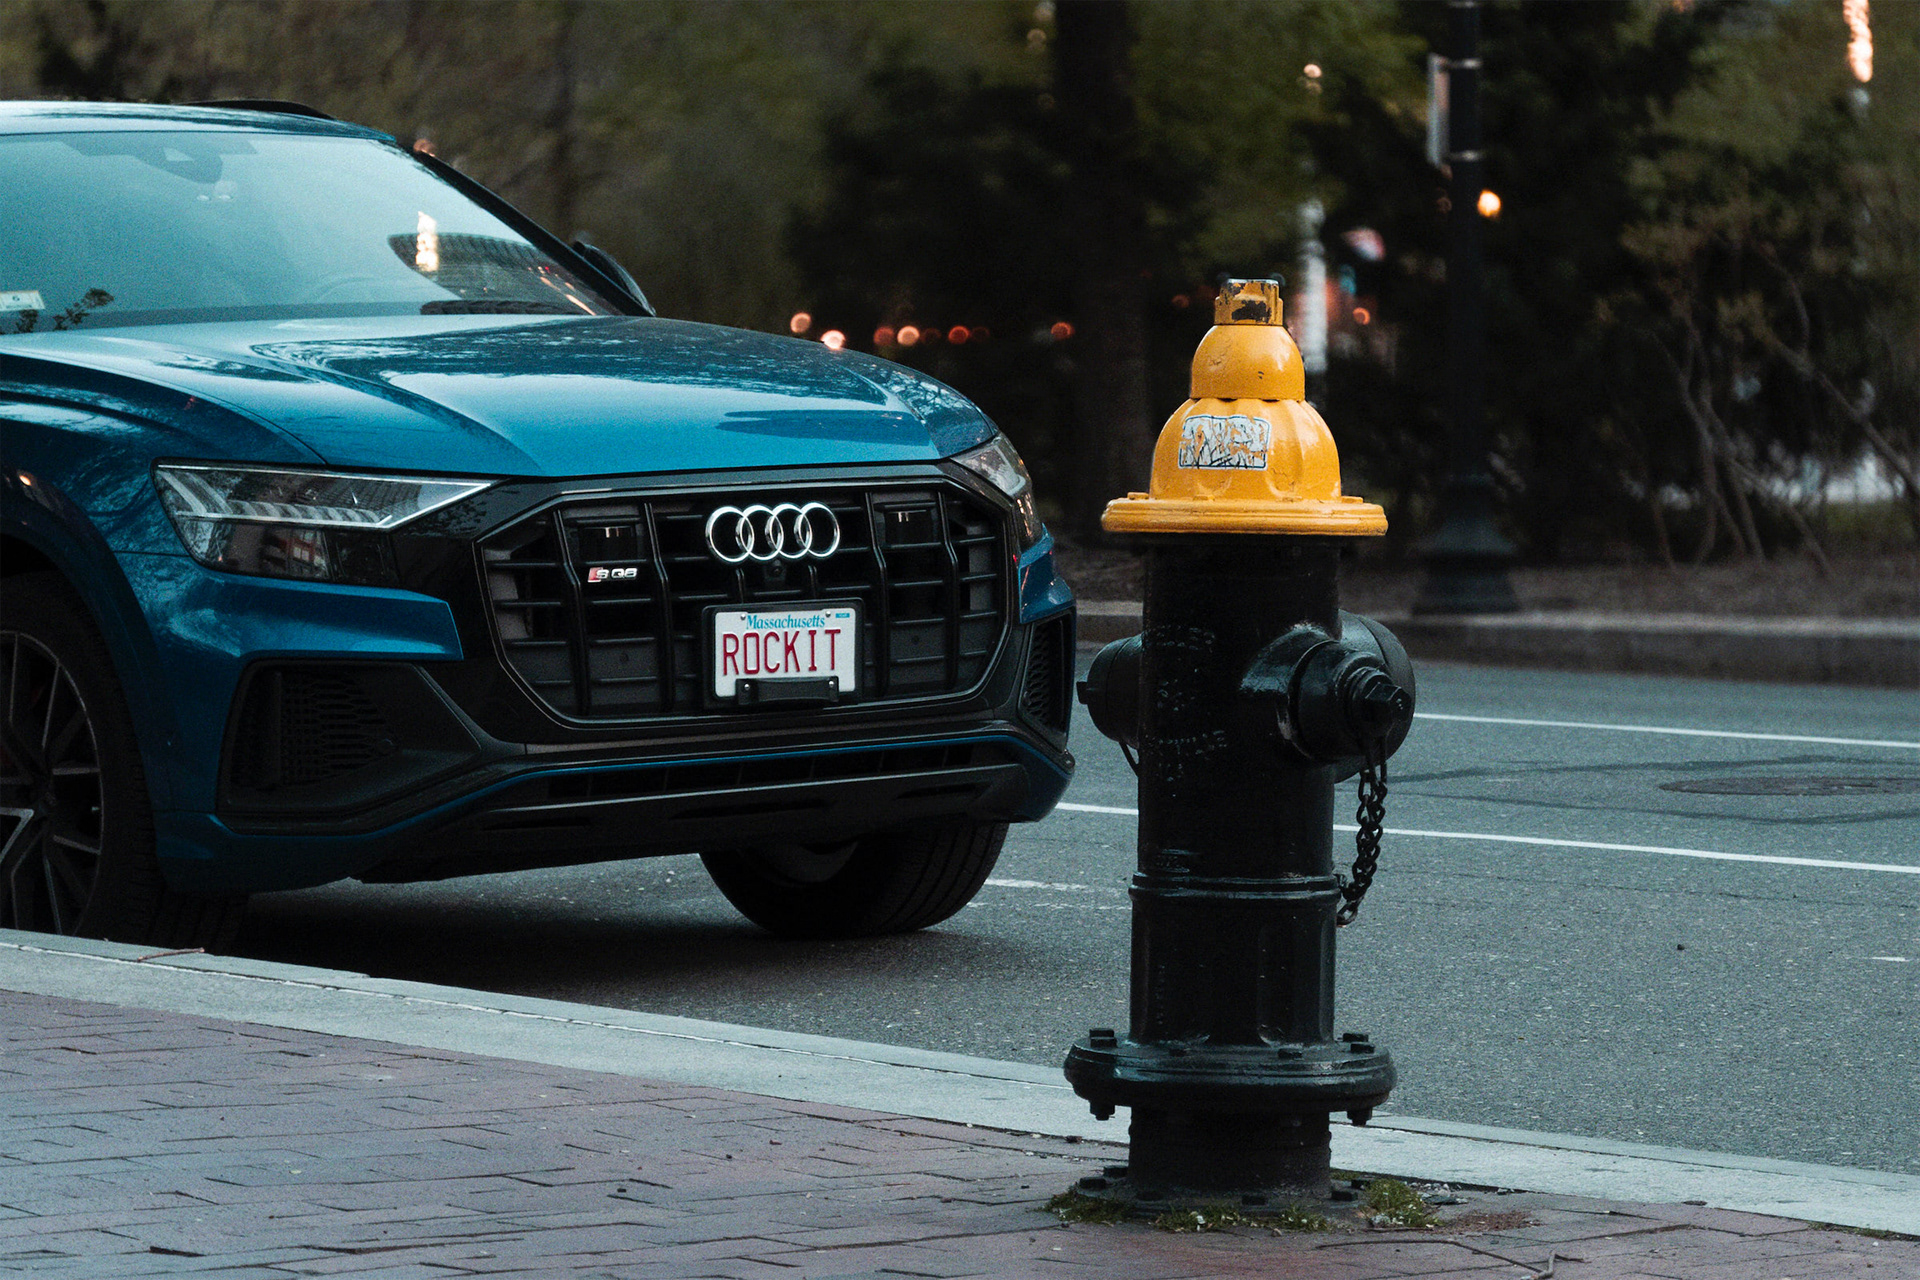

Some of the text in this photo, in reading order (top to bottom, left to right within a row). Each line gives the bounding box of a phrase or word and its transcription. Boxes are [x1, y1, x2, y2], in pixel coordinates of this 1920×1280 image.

[595, 567, 638, 580] SQ8
[746, 614, 826, 630] Massachusetts
[723, 628, 841, 677] ROCKIT
